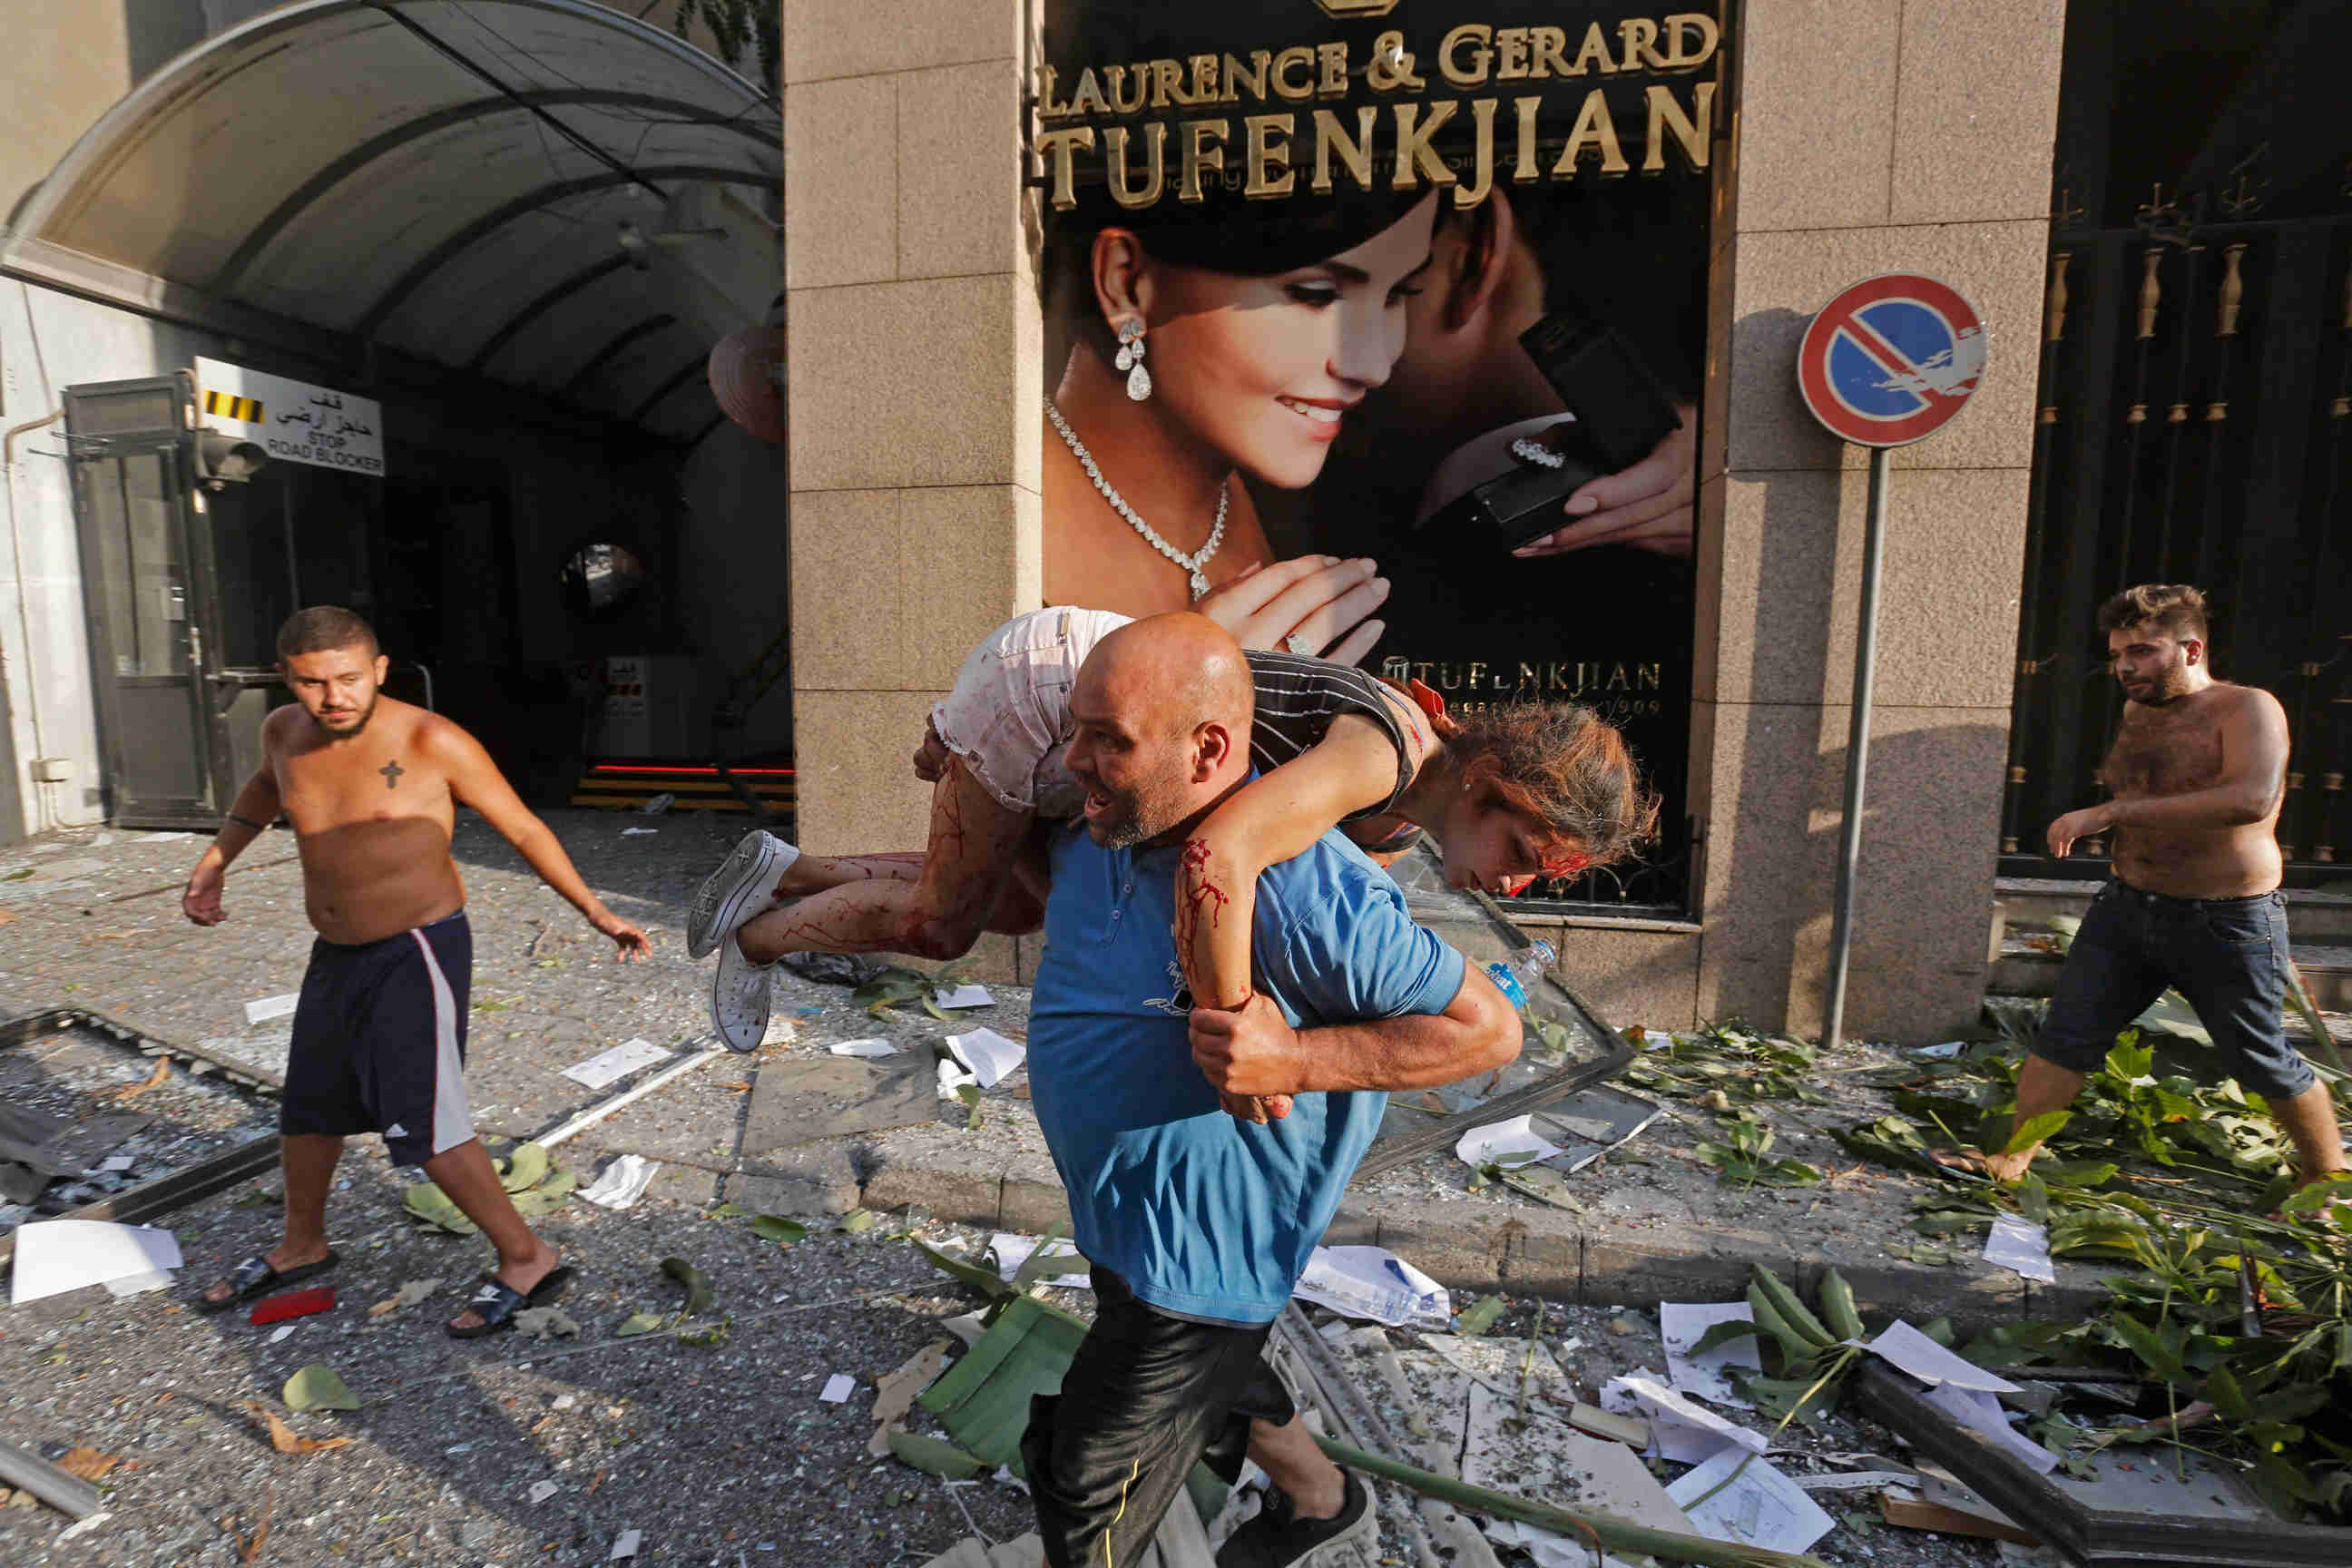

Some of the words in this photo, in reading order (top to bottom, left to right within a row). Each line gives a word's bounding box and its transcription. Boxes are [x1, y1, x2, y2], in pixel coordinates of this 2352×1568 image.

[1034, 42, 1348, 120] LAURENCE
[1367, 30, 1426, 93] &
[1438, 13, 1718, 86] GERARD
[1035, 82, 1716, 211] TUFENKJIAN
[269, 438, 310, 459] ROAD
[317, 448, 383, 470] BLOCKER
[306, 430, 346, 449] STOP
